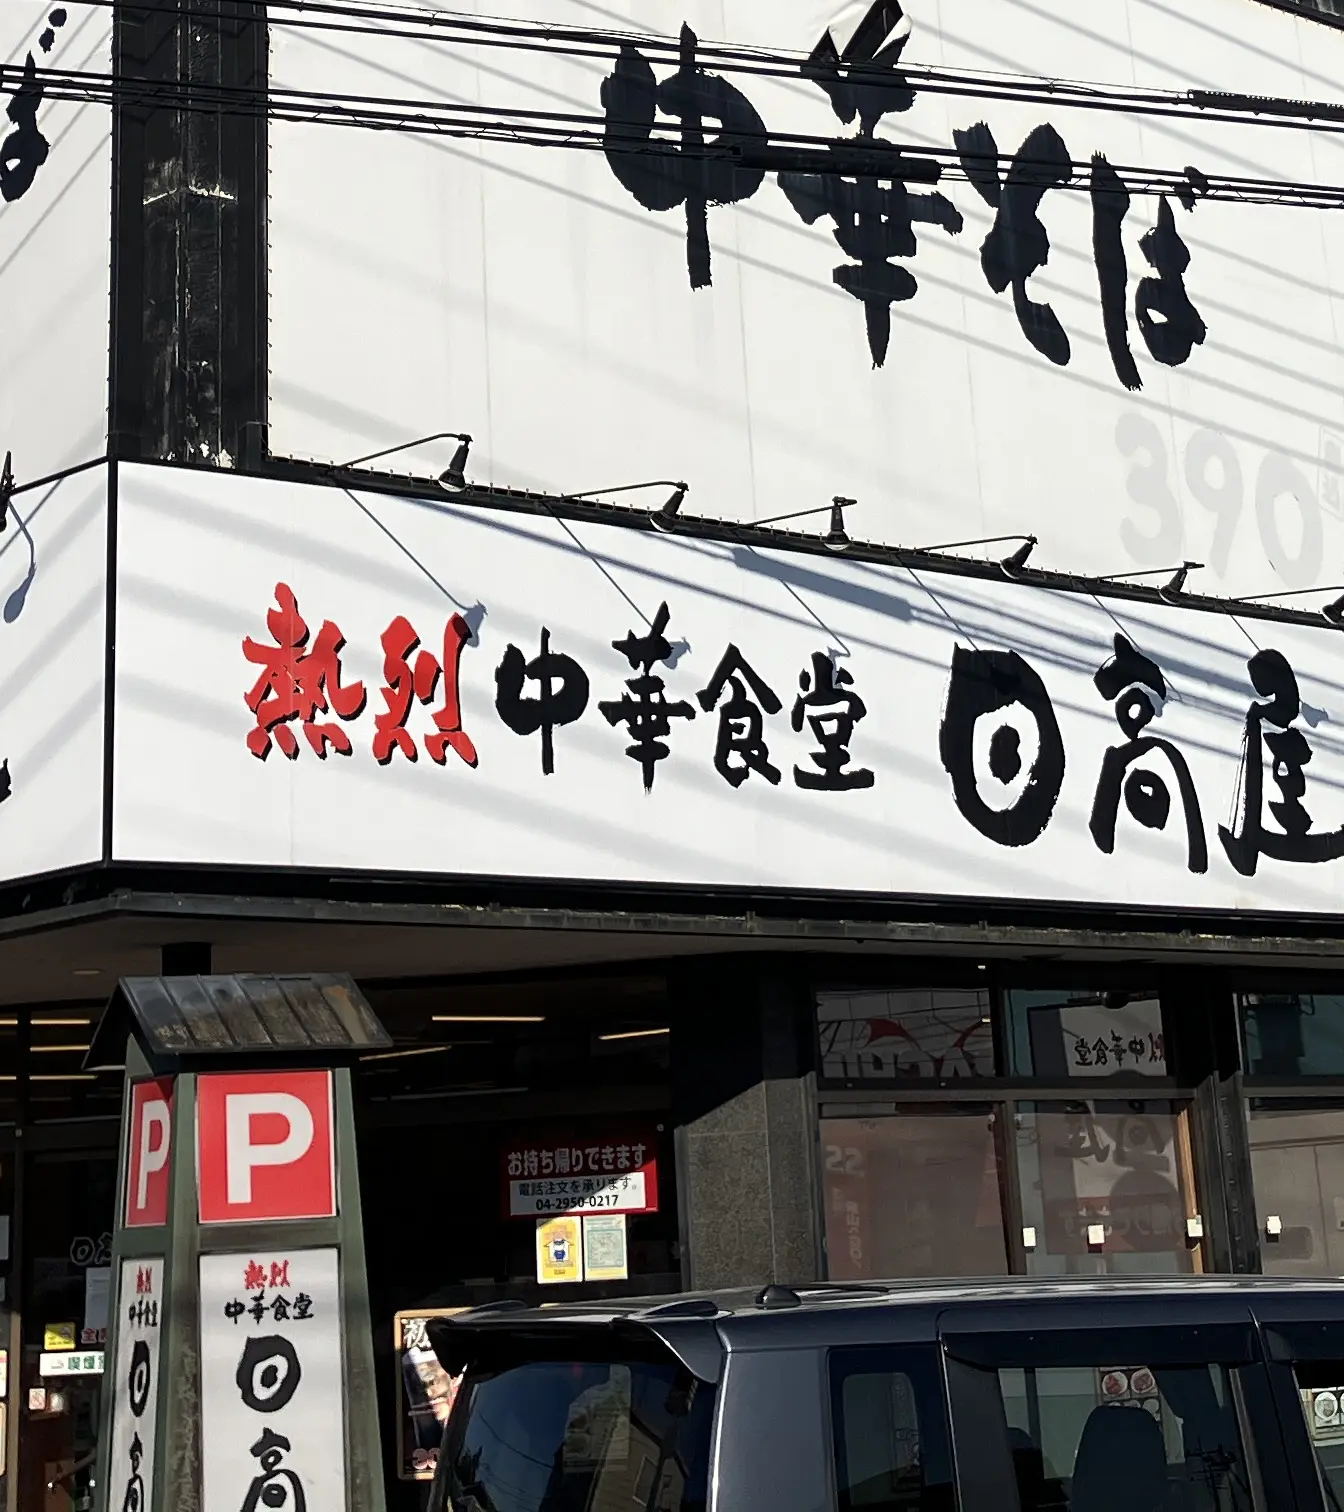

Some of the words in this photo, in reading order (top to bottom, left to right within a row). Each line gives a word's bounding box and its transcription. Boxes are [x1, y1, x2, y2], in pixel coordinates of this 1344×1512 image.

[242, 581, 479, 769] 熱烈
[494, 601, 876, 794] 中華食堂
[136, 1099, 171, 1209] P
[225, 1092, 314, 1204] P
[508, 1143, 646, 1176] お持ち帰りできます
[536, 1195, 619, 1211] 04-2950-0217
[224, 1289, 314, 1324] 中華食堂
